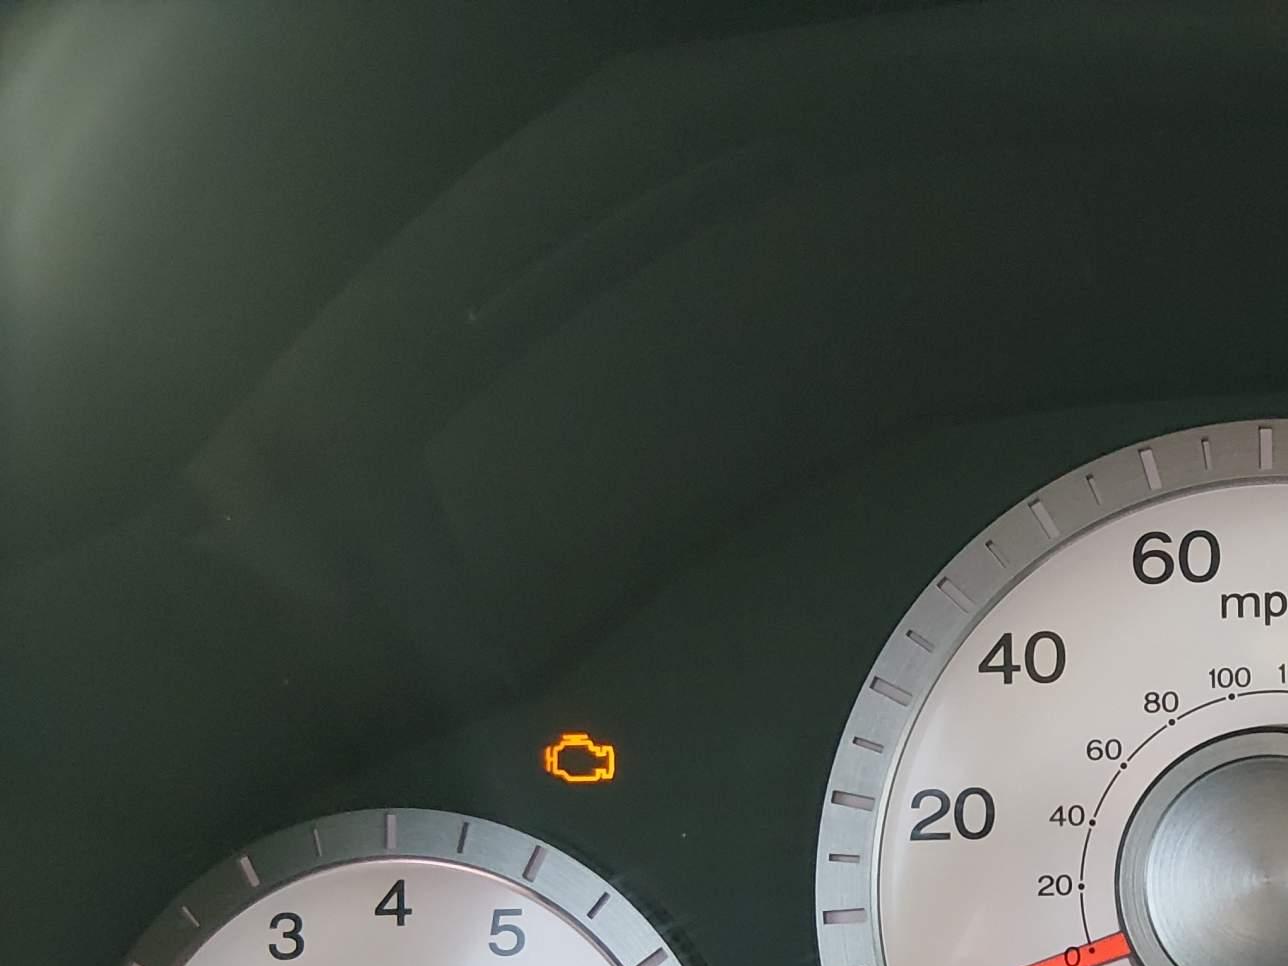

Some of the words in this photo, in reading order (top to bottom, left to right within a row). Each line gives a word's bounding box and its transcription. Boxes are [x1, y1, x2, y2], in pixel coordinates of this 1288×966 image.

[1131, 529, 1221, 585] 60
[978, 631, 1067, 685] 40
[1209, 666, 1252, 690] 100
[1143, 692, 1179, 715] 80
[1086, 739, 1123, 762] 60
[910, 788, 996, 841] 20
[1049, 806, 1087, 827] 40
[374, 879, 413, 927] 4
[1038, 875, 1073, 897] 20
[269, 912, 305, 960] 3
[488, 909, 526, 957] 5
